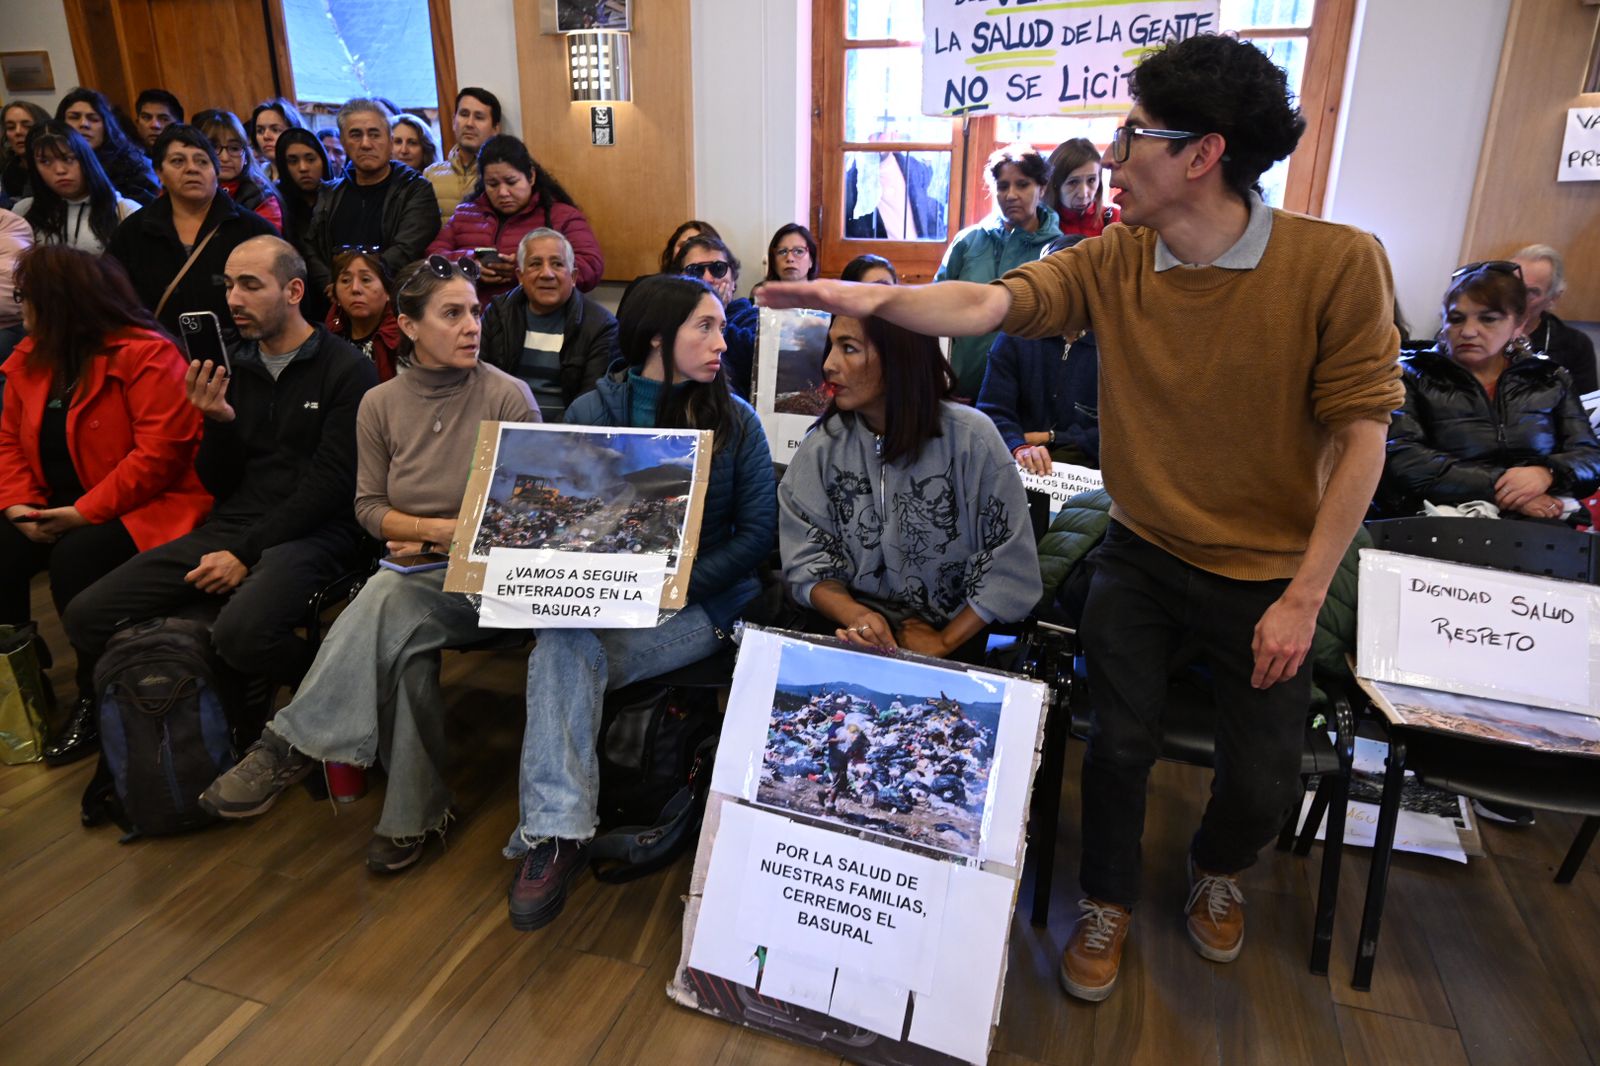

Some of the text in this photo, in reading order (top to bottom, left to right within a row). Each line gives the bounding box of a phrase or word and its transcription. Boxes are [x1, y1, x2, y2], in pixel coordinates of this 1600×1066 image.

[935, 12, 1214, 54] LA SALUD DE LA GENTE
[944, 75, 989, 108] NO
[1006, 73, 1042, 101] SE
[1036, 478, 1058, 488] LOS
[506, 567, 638, 583] ¿VAMOS A SEGUIR
[497, 584, 643, 601] ENTERRADOS EN LA
[1511, 595, 1574, 623] SALUD
[532, 604, 601, 618] BASURA?
[1431, 617, 1535, 652] RESPETO
[775, 842, 919, 891] POR LA SALUD DE
[760, 859, 928, 918] NUESTRAS FAMILIAS,
[782, 886, 896, 929] CERREMOS EL
[797, 911, 873, 945] BASURAL
